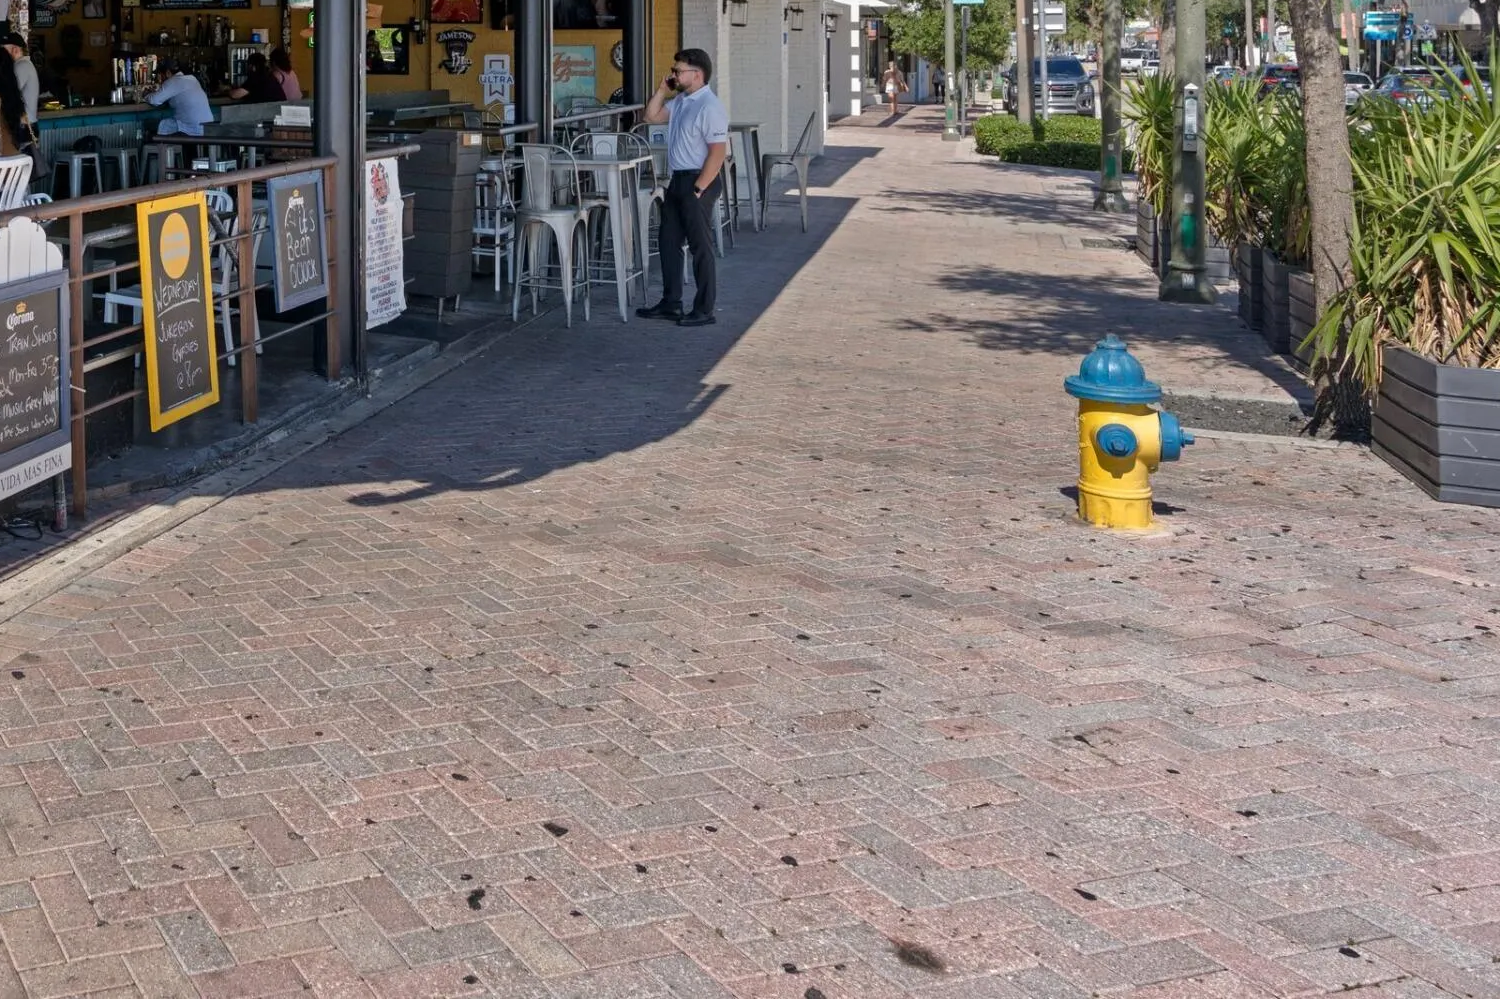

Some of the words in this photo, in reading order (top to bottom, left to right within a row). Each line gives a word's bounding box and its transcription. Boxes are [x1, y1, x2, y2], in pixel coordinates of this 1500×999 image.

[438, 31, 475, 41] JAMESON
[480, 75, 514, 84] ULTRA
[286, 233, 312, 261] Beer
[154, 272, 200, 312] WEDNESDAY
[6, 311, 35, 330] Corona
[158, 318, 195, 343] JUKEBOX
[6, 332, 29, 354] TRAIN
[31, 325, 58, 347] SHOTS
[2, 400, 25, 418] MUSIC
[0, 473, 21, 494] VIDA
[23, 463, 43, 483] MAS
[44, 453, 64, 474] FINA
